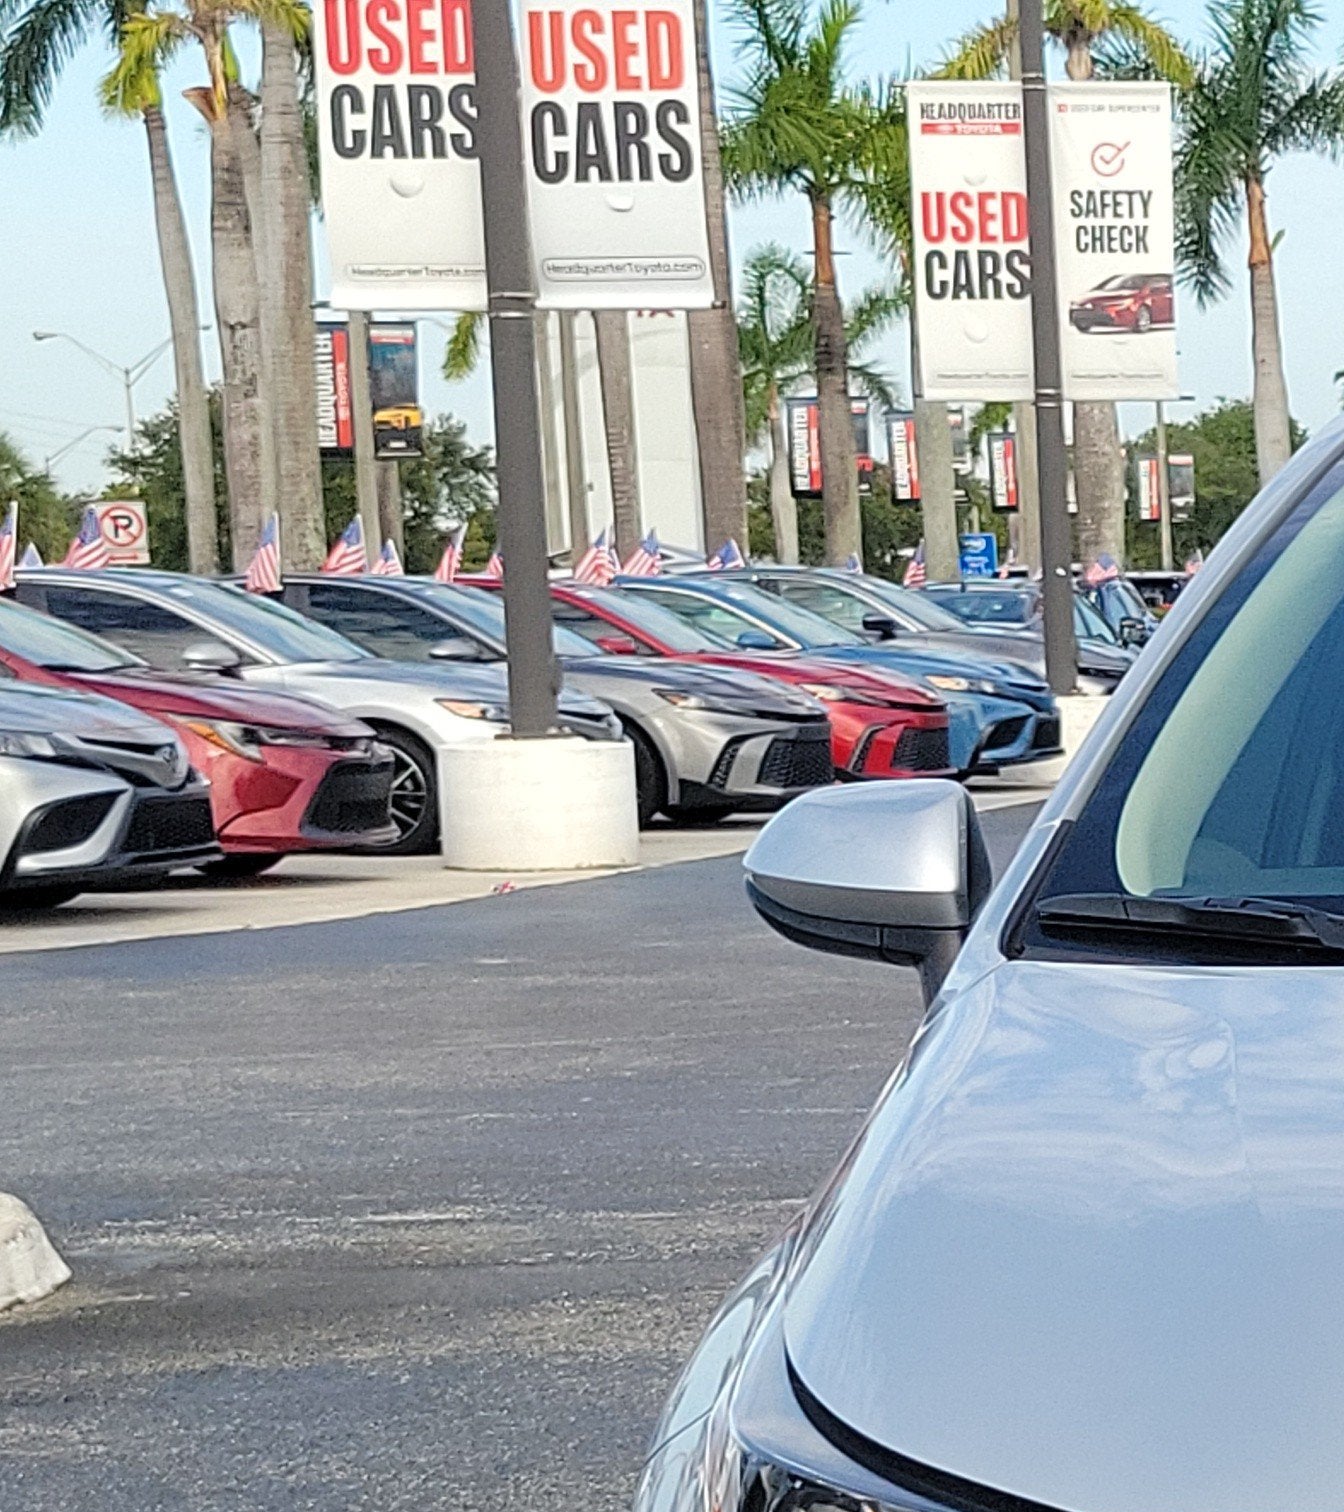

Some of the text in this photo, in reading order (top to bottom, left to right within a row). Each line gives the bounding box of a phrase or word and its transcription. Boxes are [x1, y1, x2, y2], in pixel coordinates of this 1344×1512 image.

[324, 0, 475, 75] USED
[528, 10, 684, 92] USED
[330, 84, 481, 160] CARS
[920, 102, 1021, 122] HEADQUARTER
[531, 99, 694, 184] CARS
[921, 192, 1029, 243] USED
[1070, 190, 1153, 219] SAFETY
[1076, 225, 1149, 254] CHECK
[925, 250, 1033, 300] CARS
